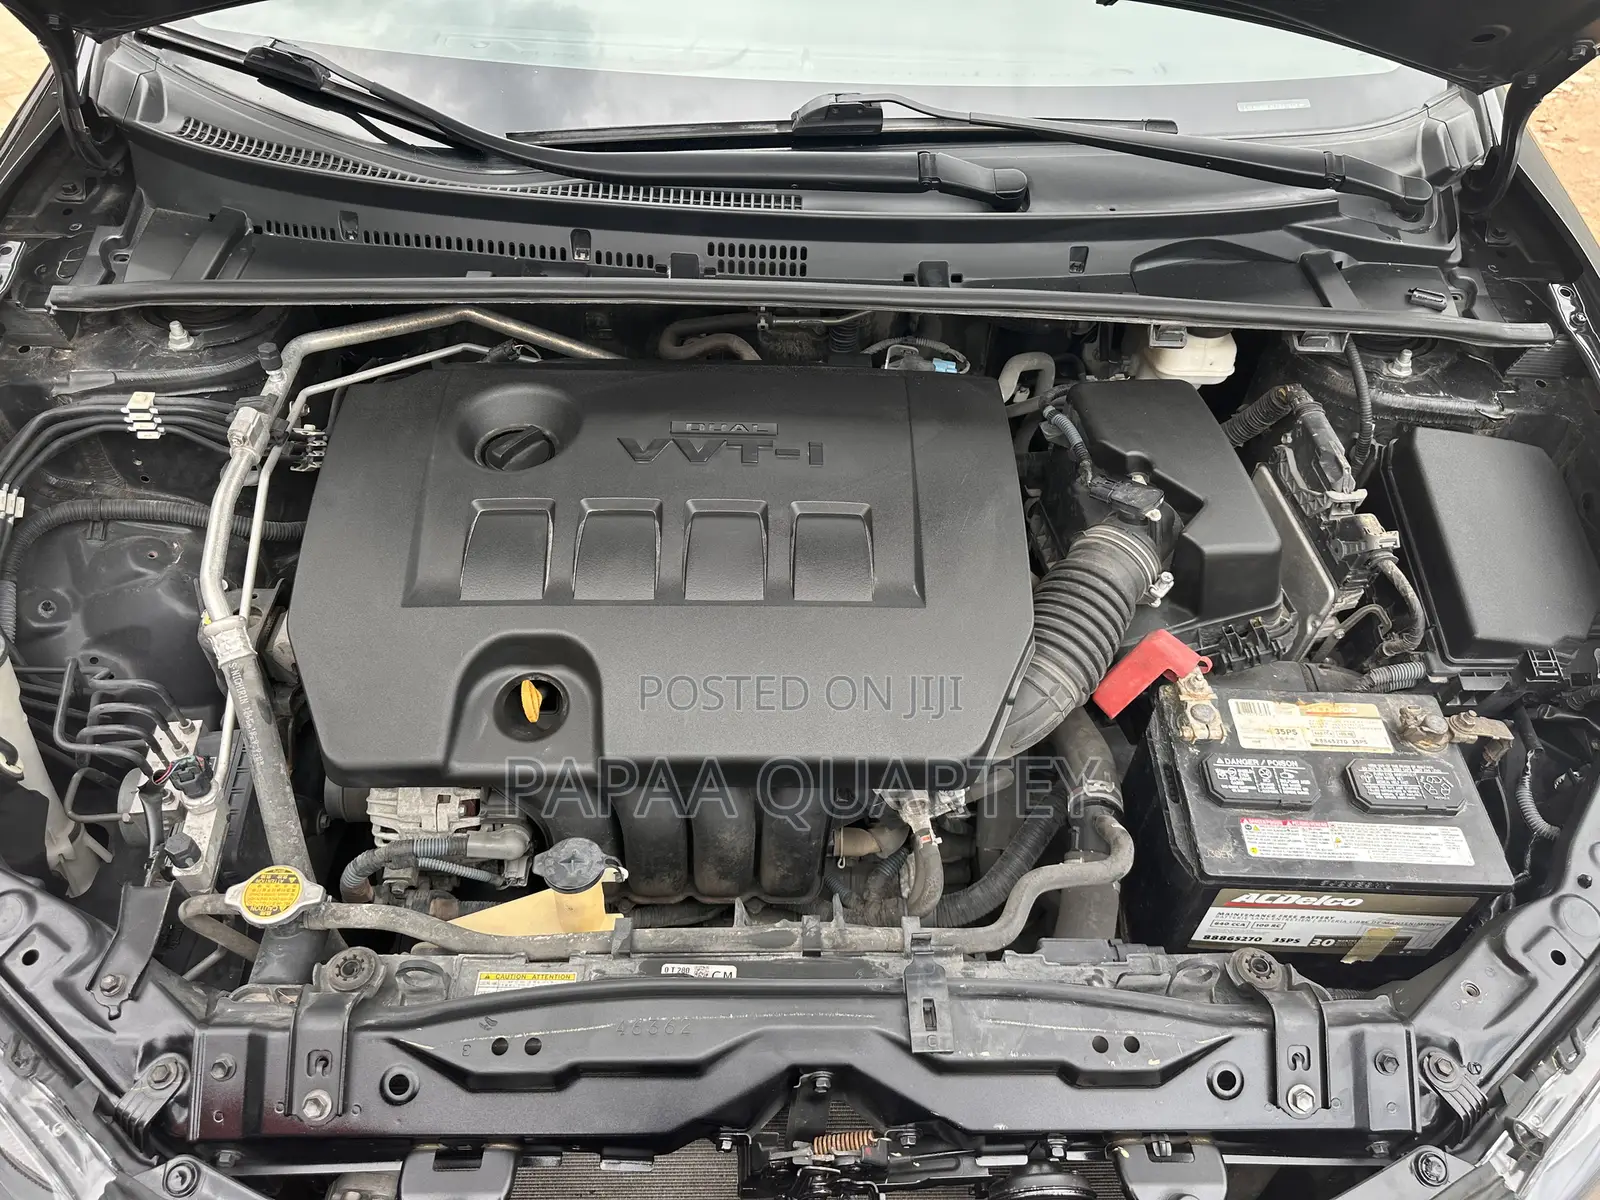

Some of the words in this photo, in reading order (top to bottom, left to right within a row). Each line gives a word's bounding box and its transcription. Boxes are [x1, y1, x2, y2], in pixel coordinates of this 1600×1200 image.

[1224, 757, 1260, 766] DANGER
[1267, 759, 1299, 768] POISON
[1231, 892, 1364, 907] ACDelco
[1216, 911, 1277, 919] MAINTENANCE
[1202, 934, 1263, 942] 88865270
[1271, 936, 1301, 944] 35PS
[1309, 937, 1336, 947] 30
